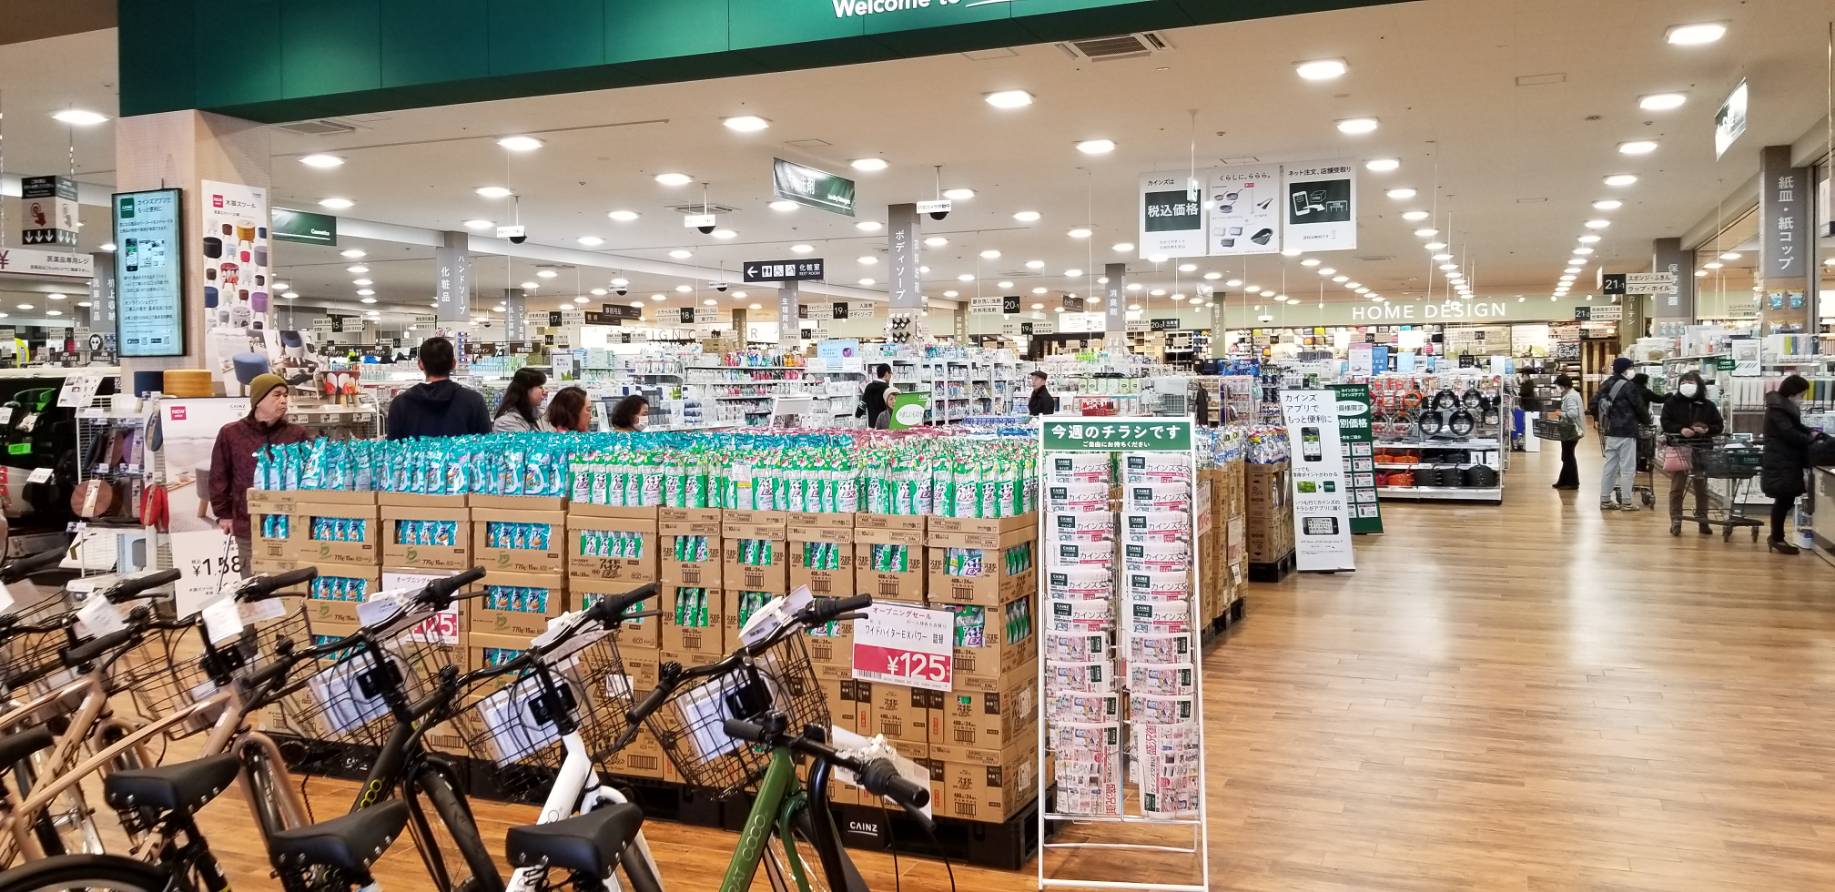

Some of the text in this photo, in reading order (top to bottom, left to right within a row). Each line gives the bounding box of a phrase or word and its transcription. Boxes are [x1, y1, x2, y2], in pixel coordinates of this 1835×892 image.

[1147, 202, 1199, 218] 税込価格
[1778, 176, 1795, 270] 紙皿・紙コップ
[895, 228, 906, 300] ボディソープ
[440, 265, 451, 302] 化粧品
[457, 255, 466, 315] ハンドソープ
[1352, 302, 1506, 321] HOME DESIGN
[1285, 393, 1318, 403] カインズ
[1286, 404, 1320, 413] アプリで
[1287, 415, 1333, 425] もっと便利に
[1339, 418, 1368, 428] 別価格
[1051, 424, 1181, 440] 今週のチラシです
[1082, 440, 1151, 448] ご自由にお持ちください
[872, 606, 932, 620] オープニングセール
[887, 652, 947, 682] ¥125
[849, 820, 879, 834] CAINZ
